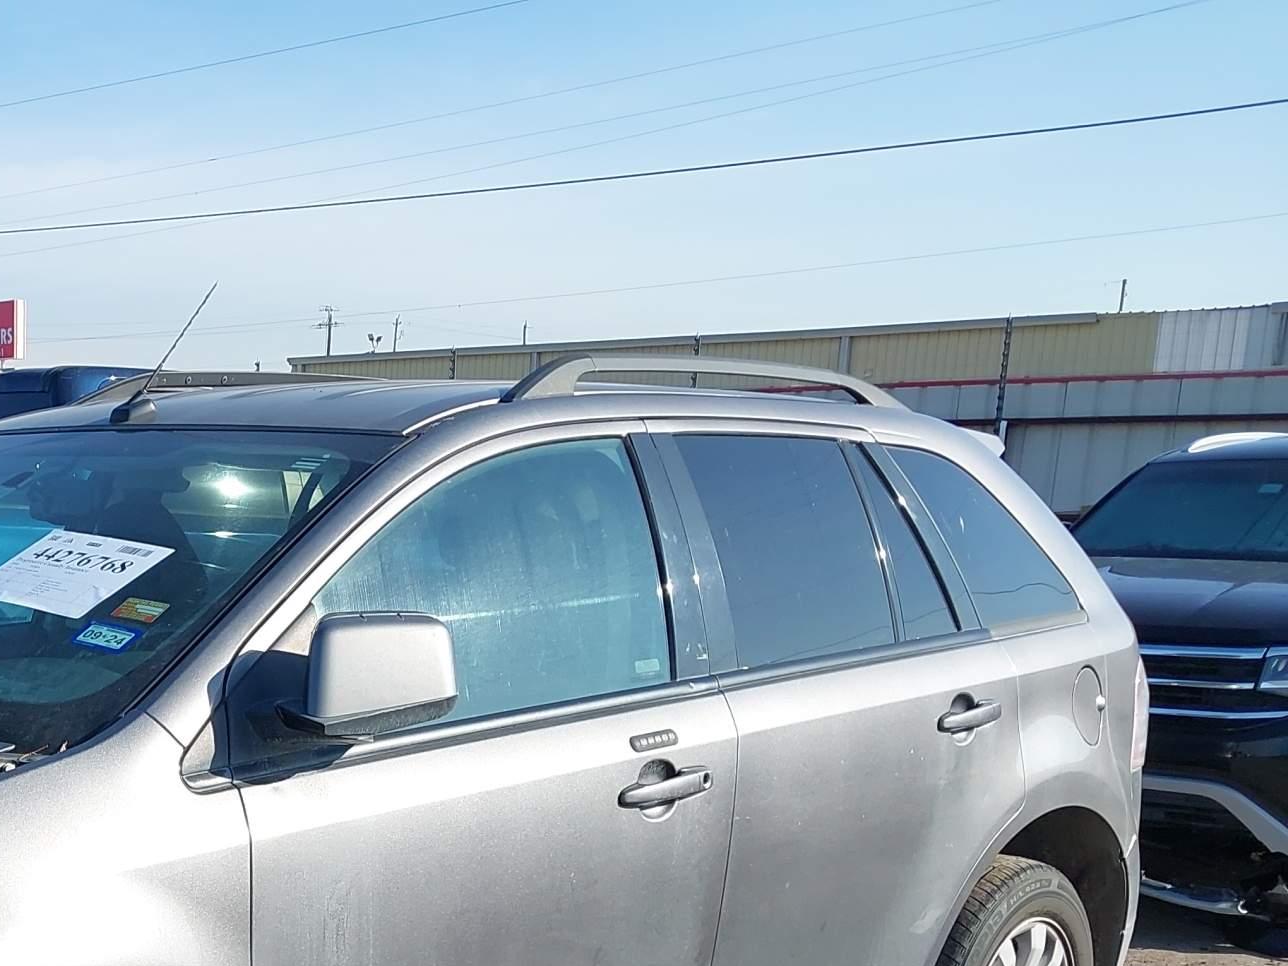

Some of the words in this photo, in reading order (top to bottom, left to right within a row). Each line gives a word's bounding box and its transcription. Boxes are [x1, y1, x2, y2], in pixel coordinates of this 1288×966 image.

[33, 546, 135, 574] 44276768
[82, 629, 103, 640] 09
[104, 635, 127, 646] 24
